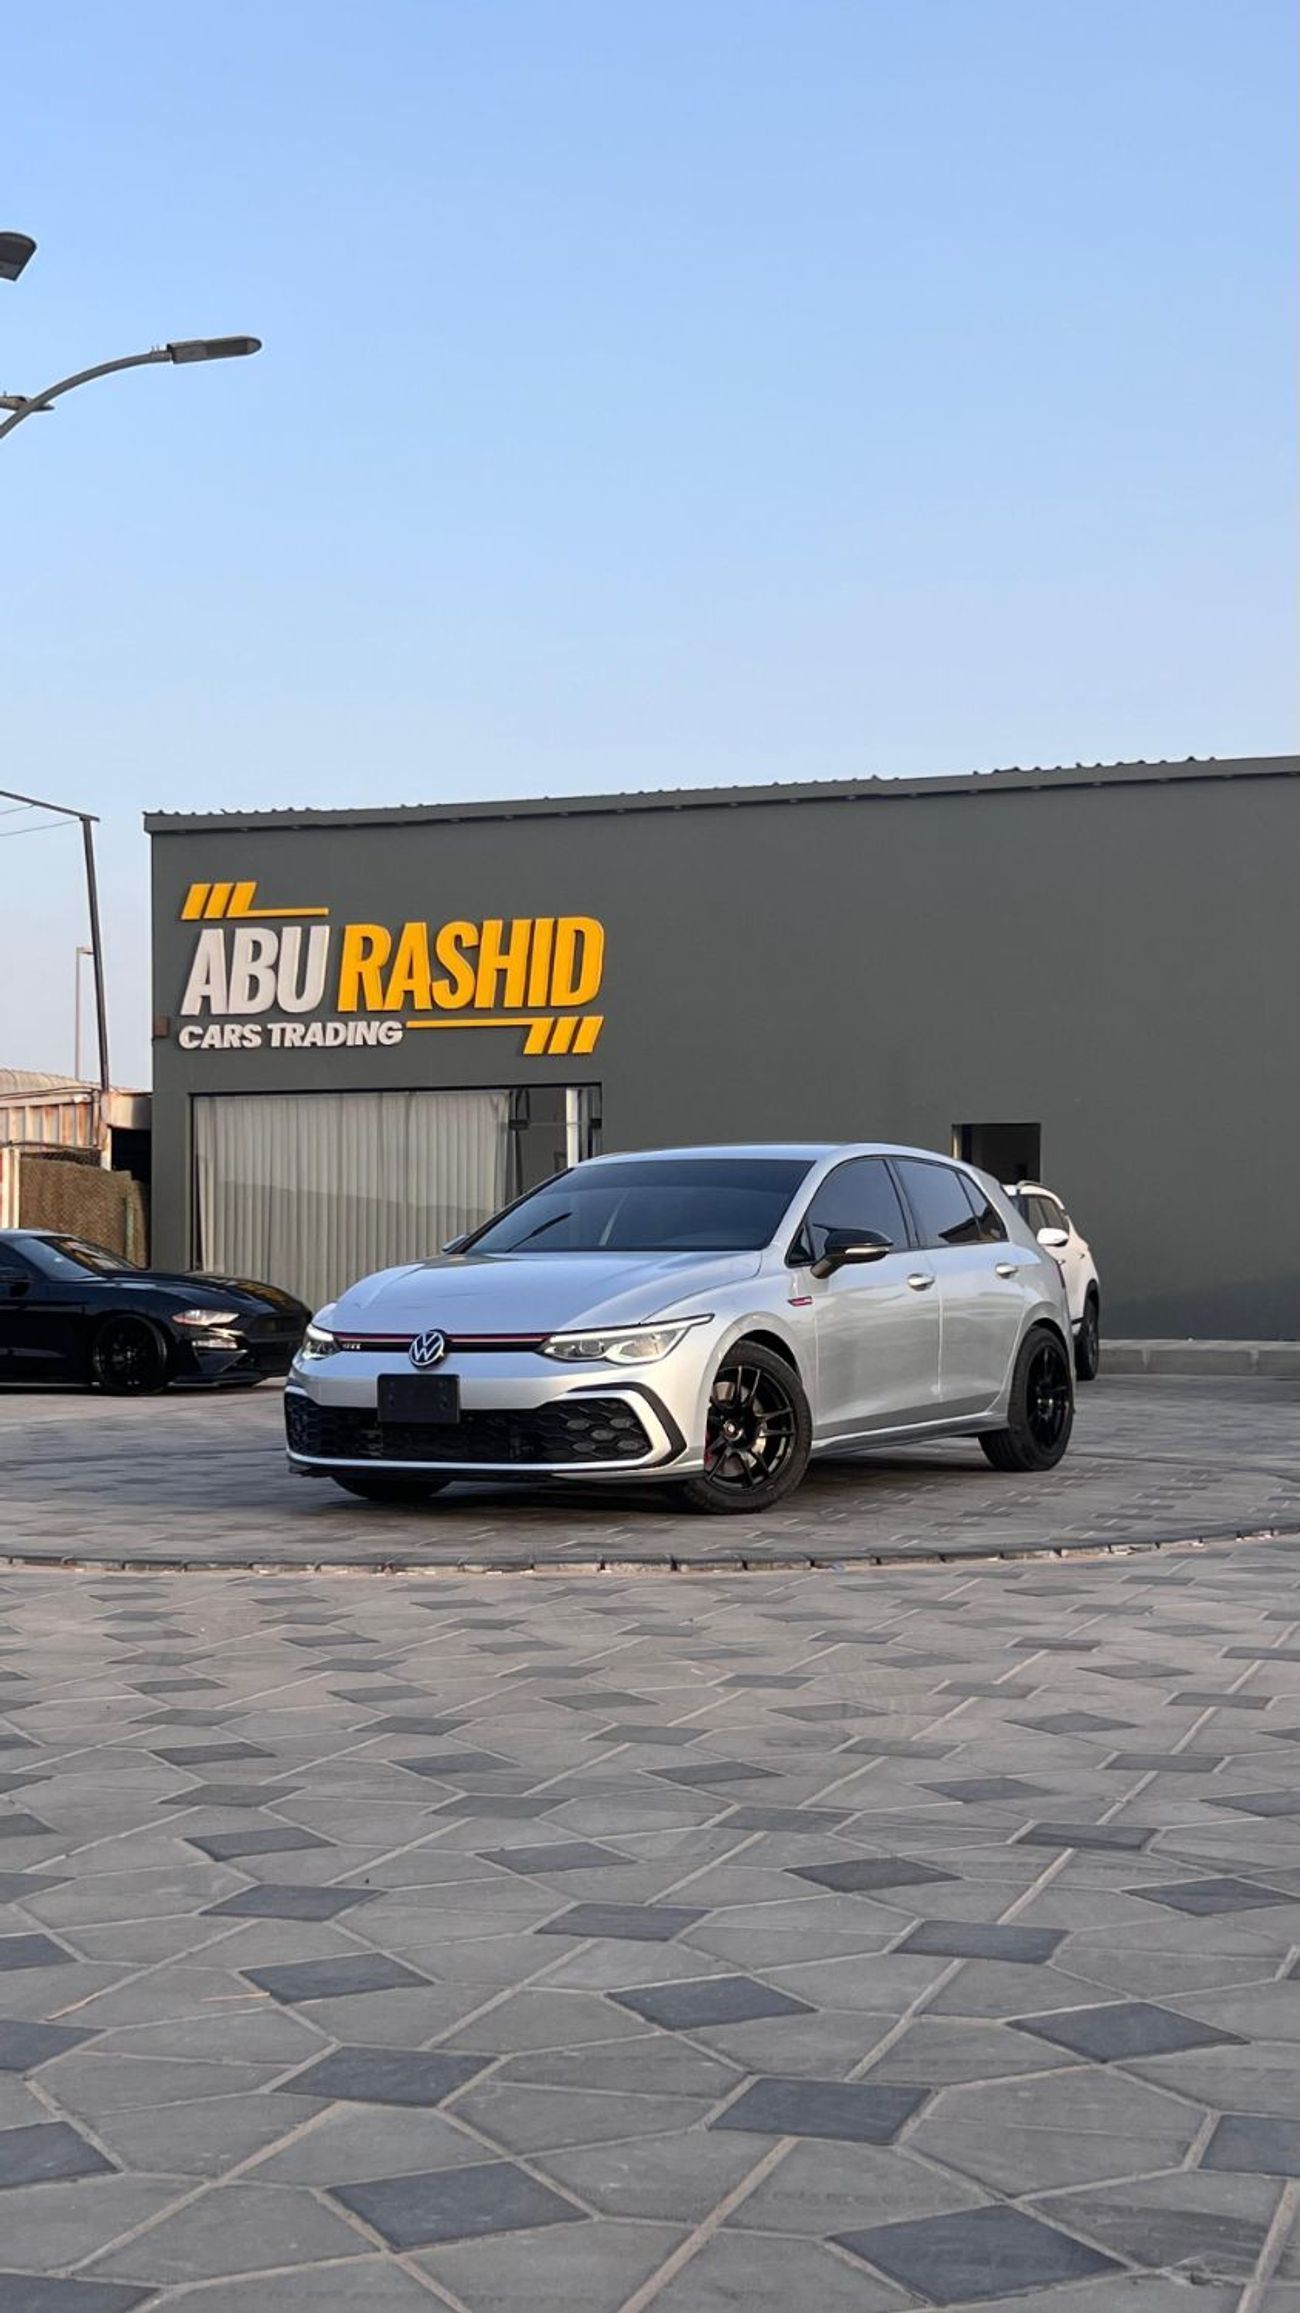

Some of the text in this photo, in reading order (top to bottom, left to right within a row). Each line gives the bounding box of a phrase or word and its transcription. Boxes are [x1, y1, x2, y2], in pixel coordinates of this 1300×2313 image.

[180, 916, 605, 1016] ABU RASHID
[178, 1020, 404, 1049] CARS TRADING
